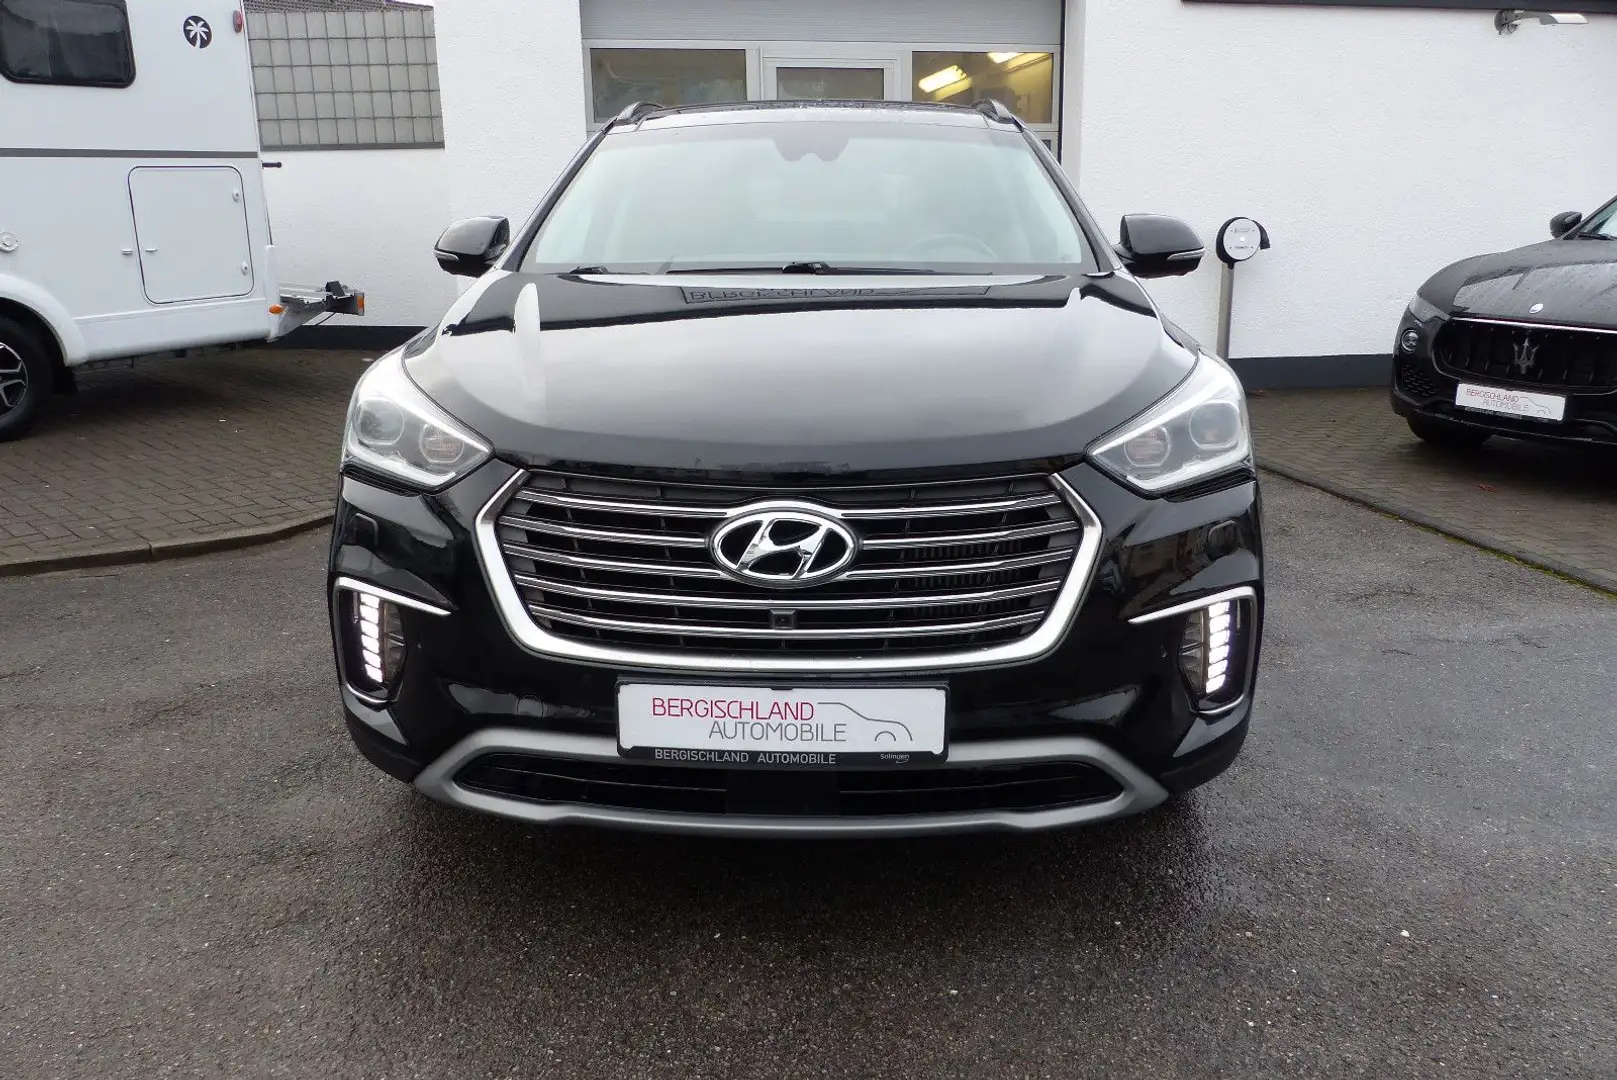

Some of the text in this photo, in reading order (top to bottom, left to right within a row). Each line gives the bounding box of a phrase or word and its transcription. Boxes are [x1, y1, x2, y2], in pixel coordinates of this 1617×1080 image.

[1466, 388, 1520, 403] BERGISCHLAND
[1482, 398, 1529, 412] AUTOMOBILE
[651, 697, 815, 722] BERGISCHLAND
[708, 721, 847, 743] AUTOMOBILE
[654, 749, 837, 765] BERGISCHLAND AUTOMOBILE
[880, 753, 910, 763] Solingen
